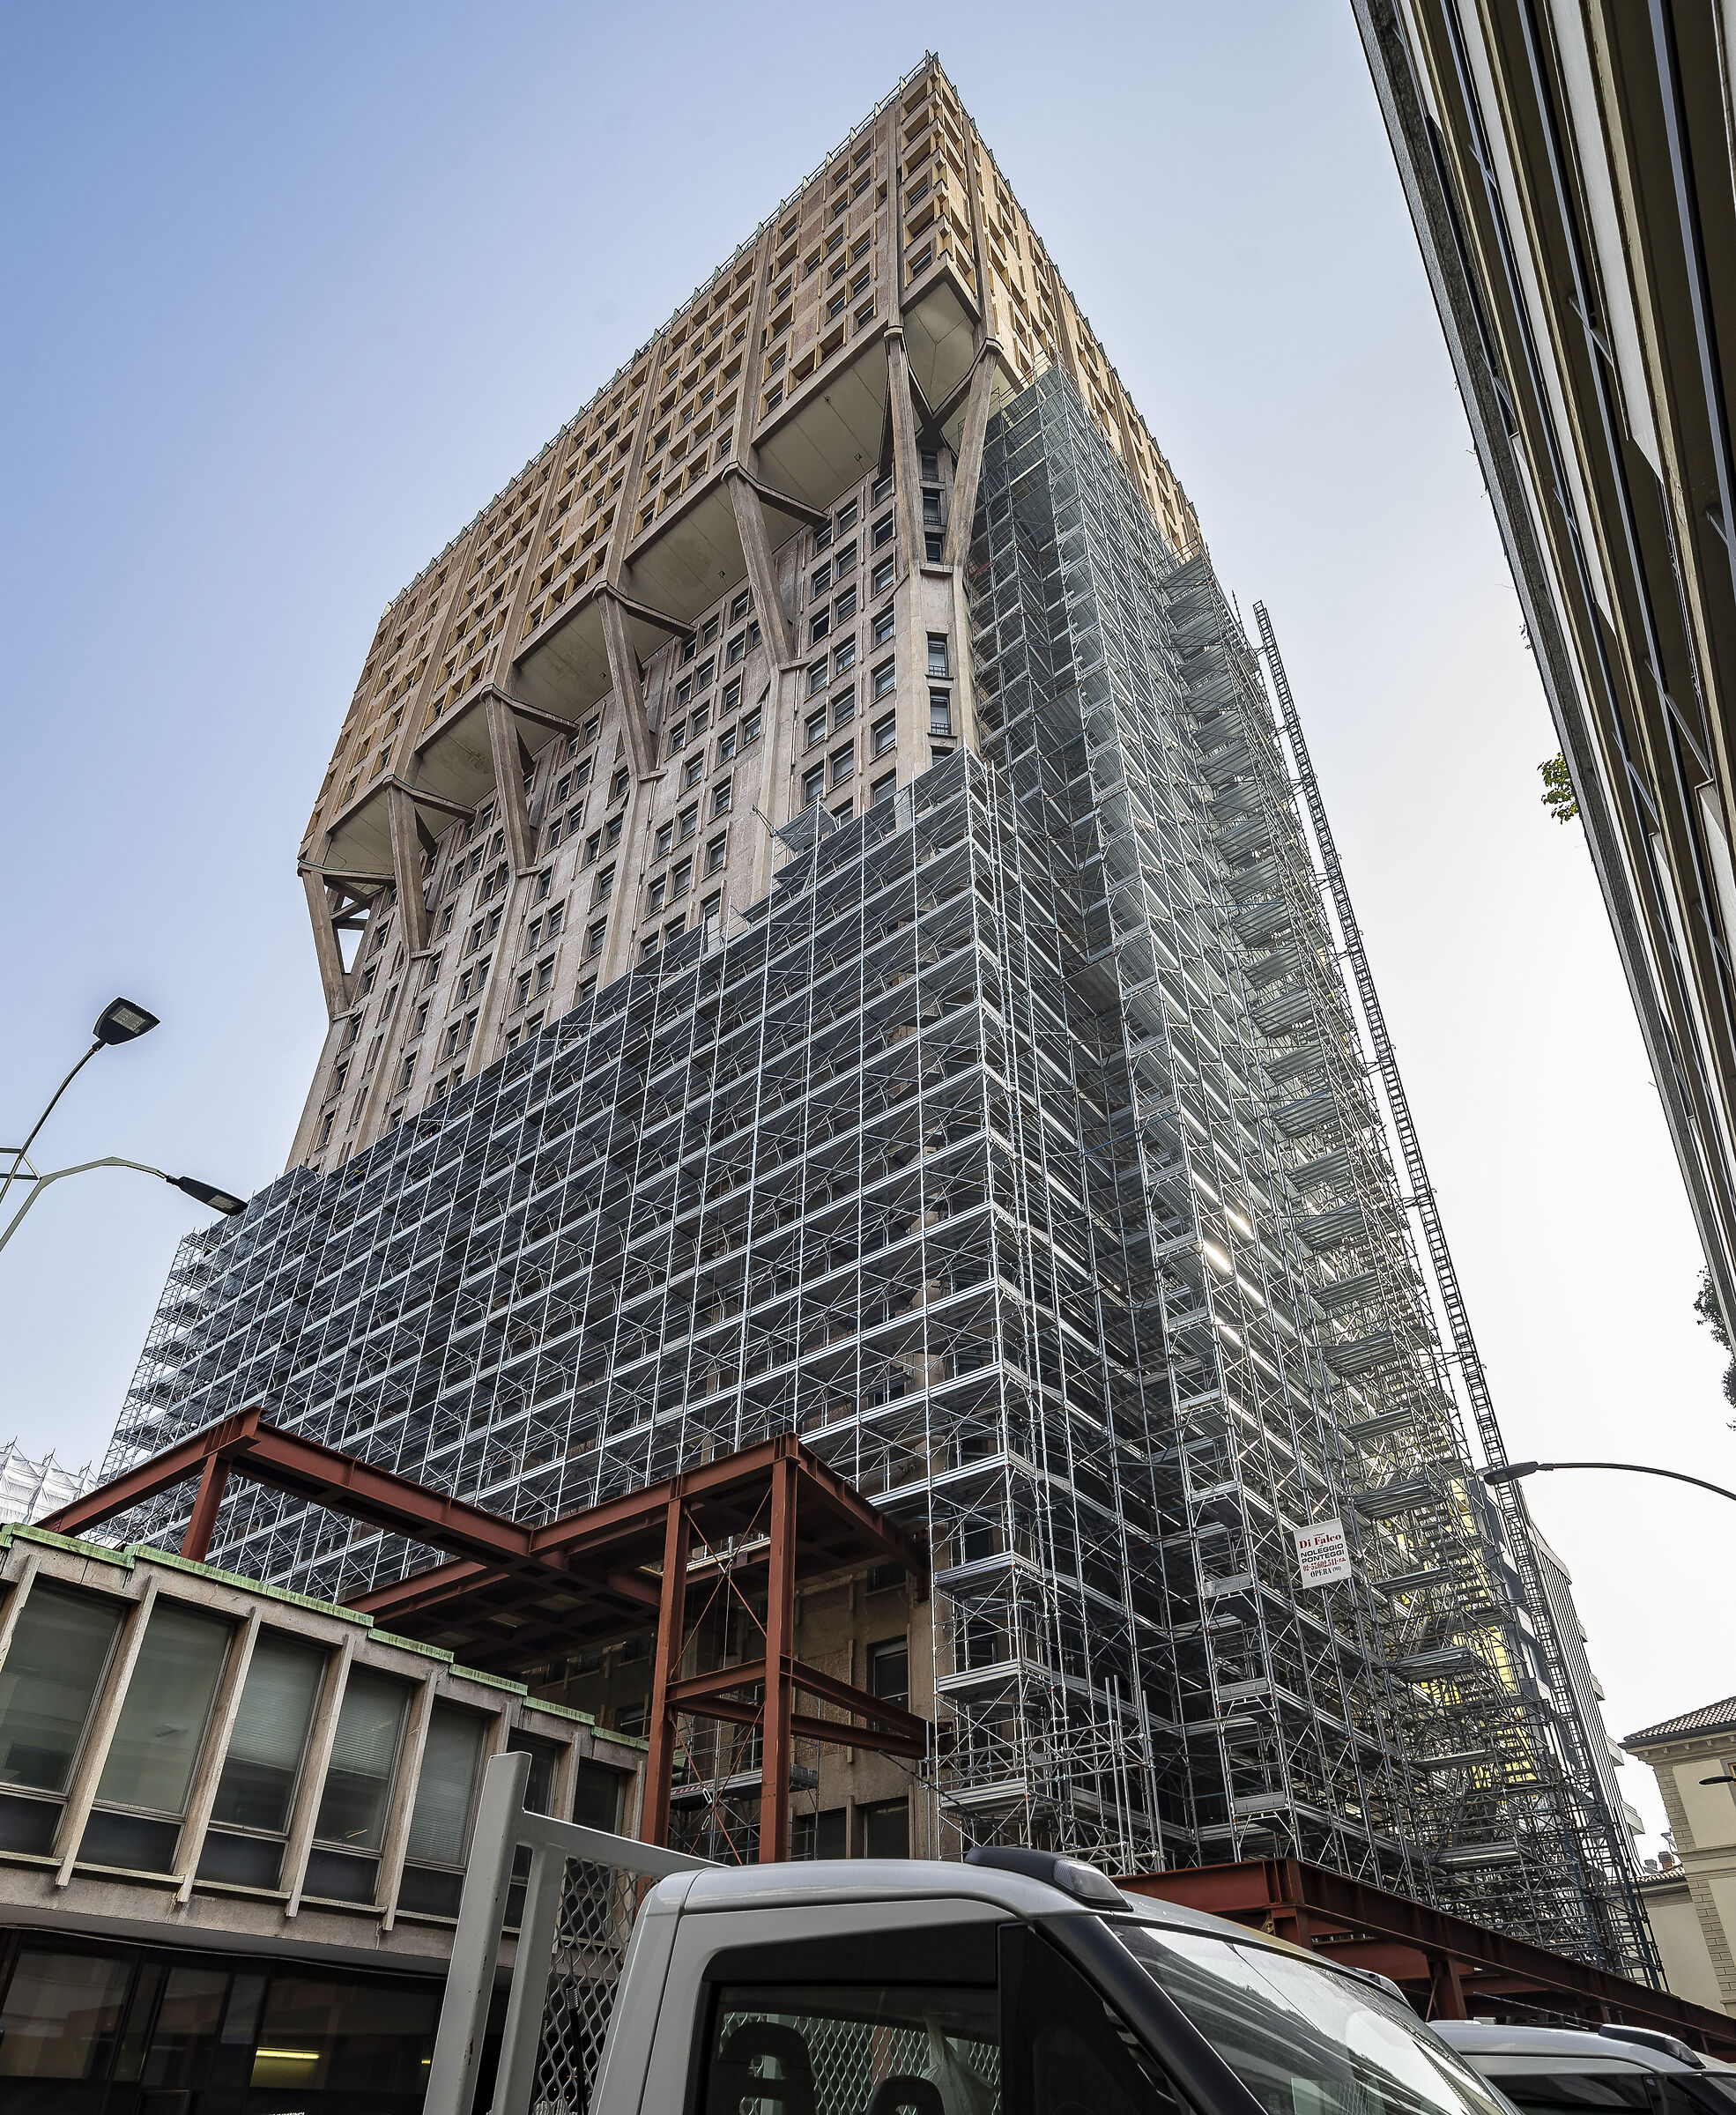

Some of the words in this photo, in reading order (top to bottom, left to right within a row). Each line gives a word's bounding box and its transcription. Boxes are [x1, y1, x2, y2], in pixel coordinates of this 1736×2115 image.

[1299, 1540, 1311, 1548] Di
[1314, 1534, 1342, 1546] Falco
[1301, 1543, 1344, 1558] NOLEGGIO
[1302, 1549, 1345, 1564] PONTEGGI
[1310, 1567, 1332, 1577] OPERA
